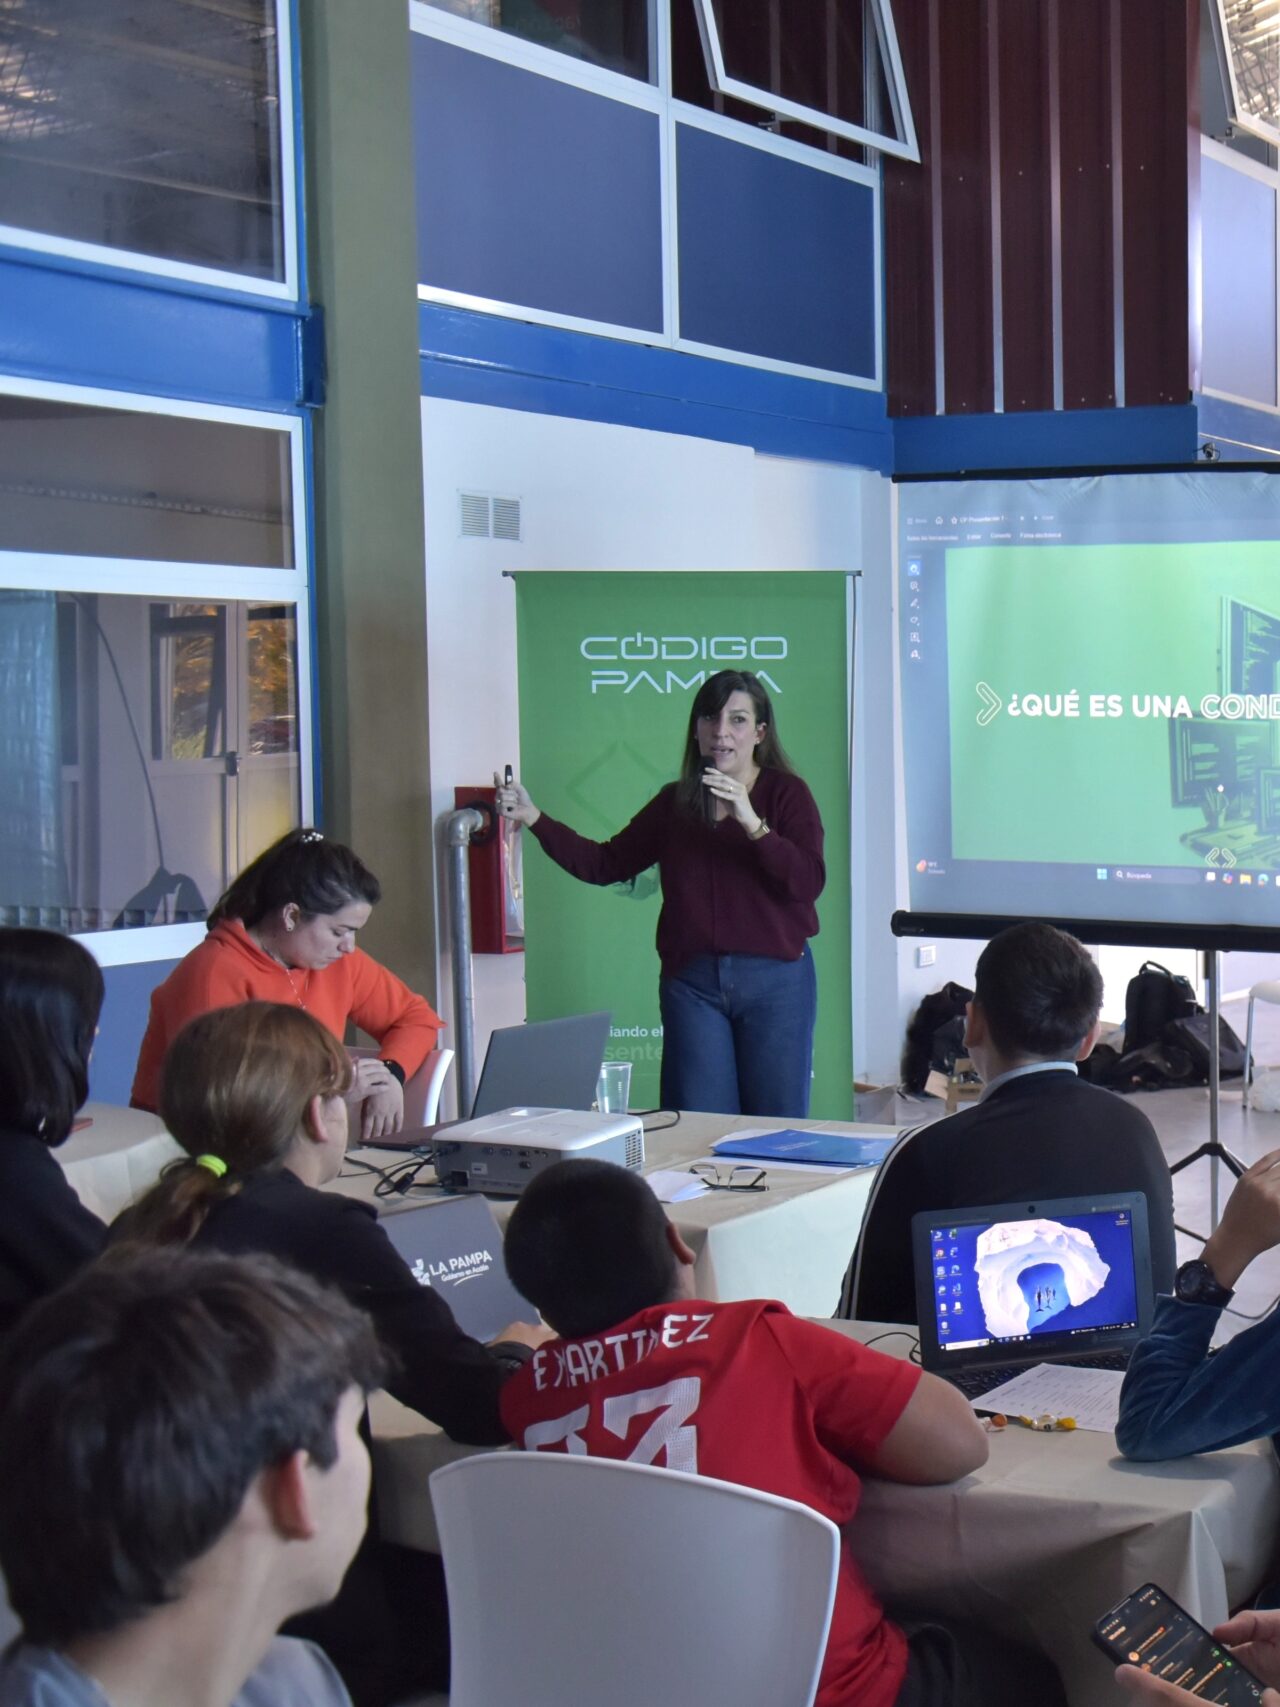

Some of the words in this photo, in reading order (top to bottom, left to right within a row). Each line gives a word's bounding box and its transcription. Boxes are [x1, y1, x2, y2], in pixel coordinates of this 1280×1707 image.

[591, 670, 782, 694] PAMA
[1007, 689, 1080, 719] ¿QUÉ
[1089, 694, 1123, 718] ES
[1132, 694, 1193, 718] UNA
[609, 1026, 648, 1038] iando
[604, 1042, 664, 1062] sente
[429, 1261, 449, 1276] LA
[449, 1250, 493, 1271] PAMPA
